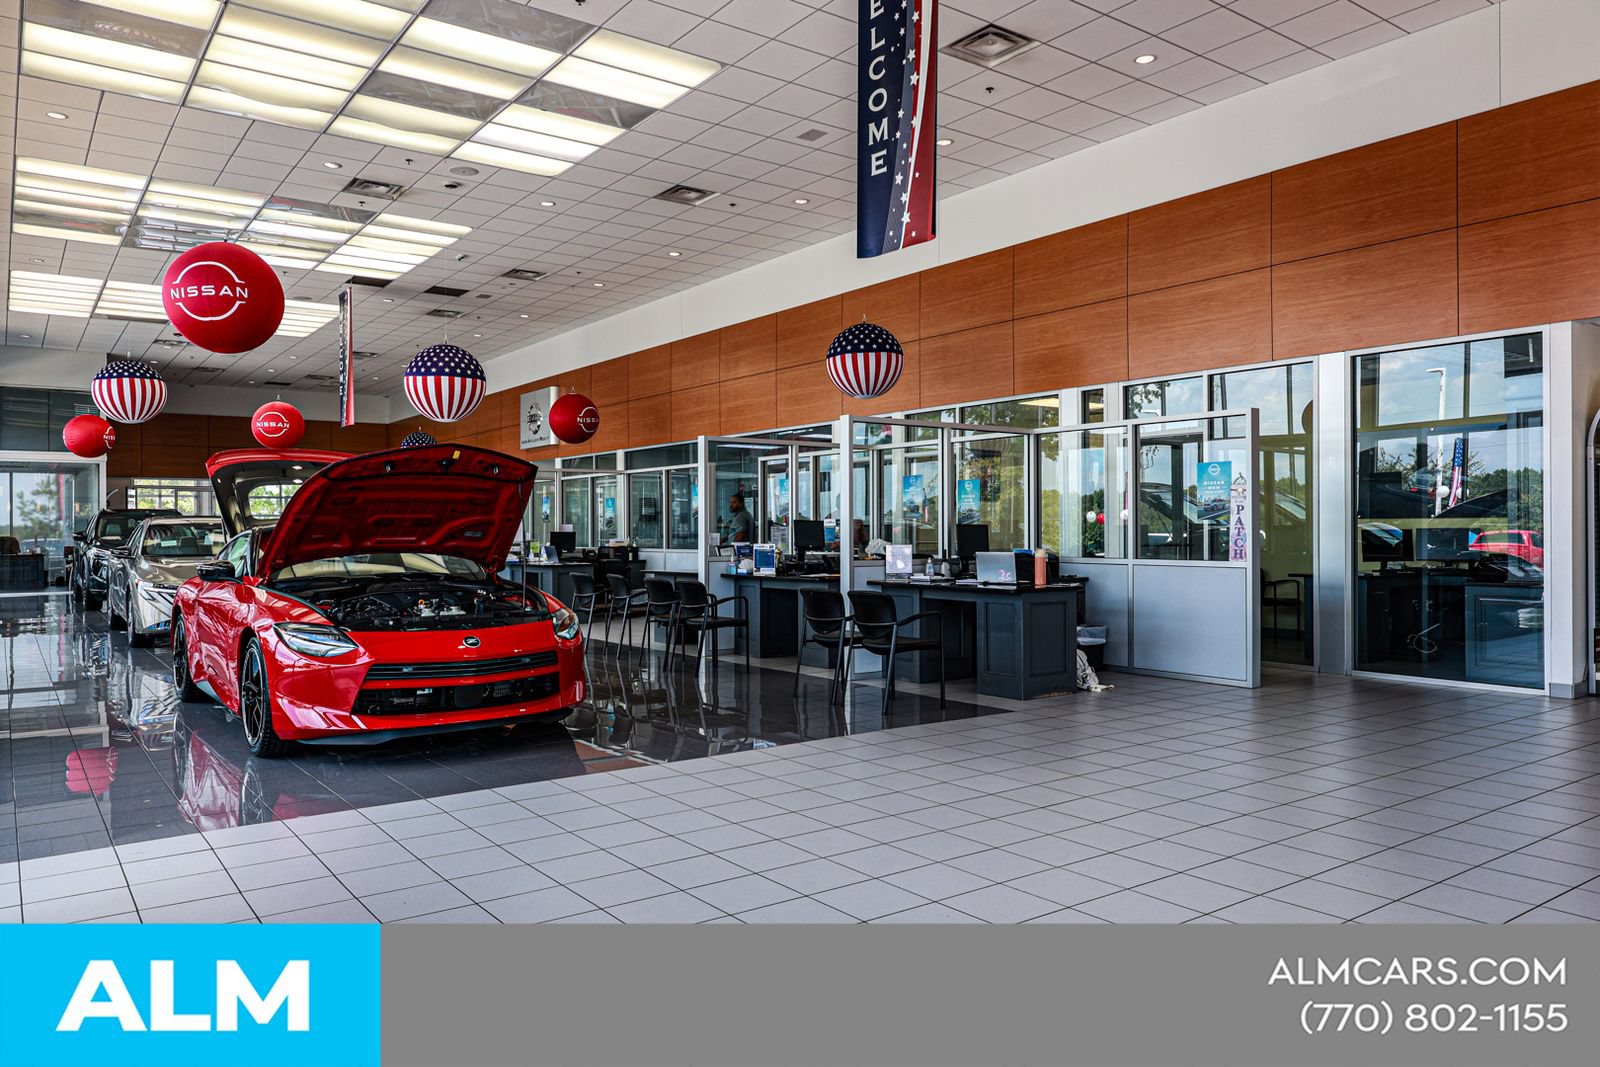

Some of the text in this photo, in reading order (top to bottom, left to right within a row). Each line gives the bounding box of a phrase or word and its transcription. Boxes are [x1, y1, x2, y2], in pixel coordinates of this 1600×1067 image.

[170, 285, 249, 300] NISSAN
[256, 421, 290, 429] NISSAN
[1234, 504, 1245, 560] PATCH
